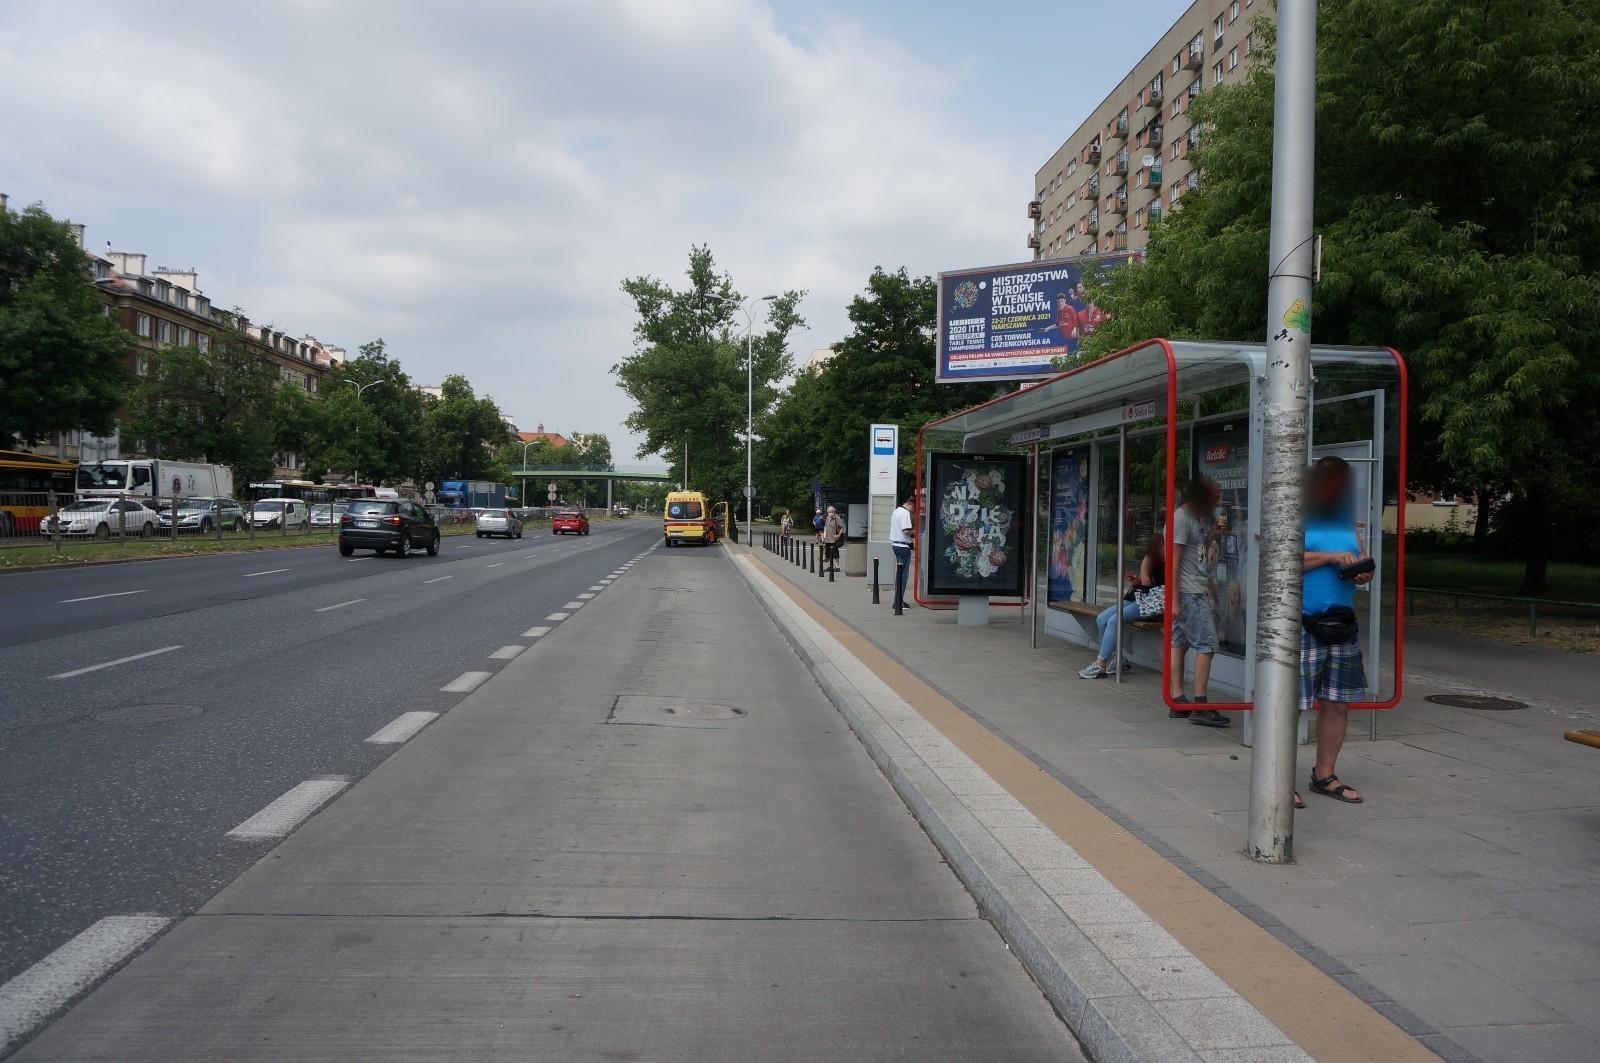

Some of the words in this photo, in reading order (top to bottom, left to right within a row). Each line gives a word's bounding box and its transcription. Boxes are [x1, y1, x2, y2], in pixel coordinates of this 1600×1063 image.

[992, 269, 1069, 287] MISTRZOSTWA
[992, 283, 1033, 297] EUROPY
[991, 296, 1003, 306] W
[1005, 292, 1044, 305] TENISIE
[991, 300, 1051, 316] STOŁOWYM
[1007, 315, 1036, 323] CZERWCA
[949, 325, 967, 334] 2020
[968, 324, 986, 333] ITTF
[991, 322, 1027, 330] WARSZAWA
[990, 339, 1041, 349] ŁAZIENKOWSKA
